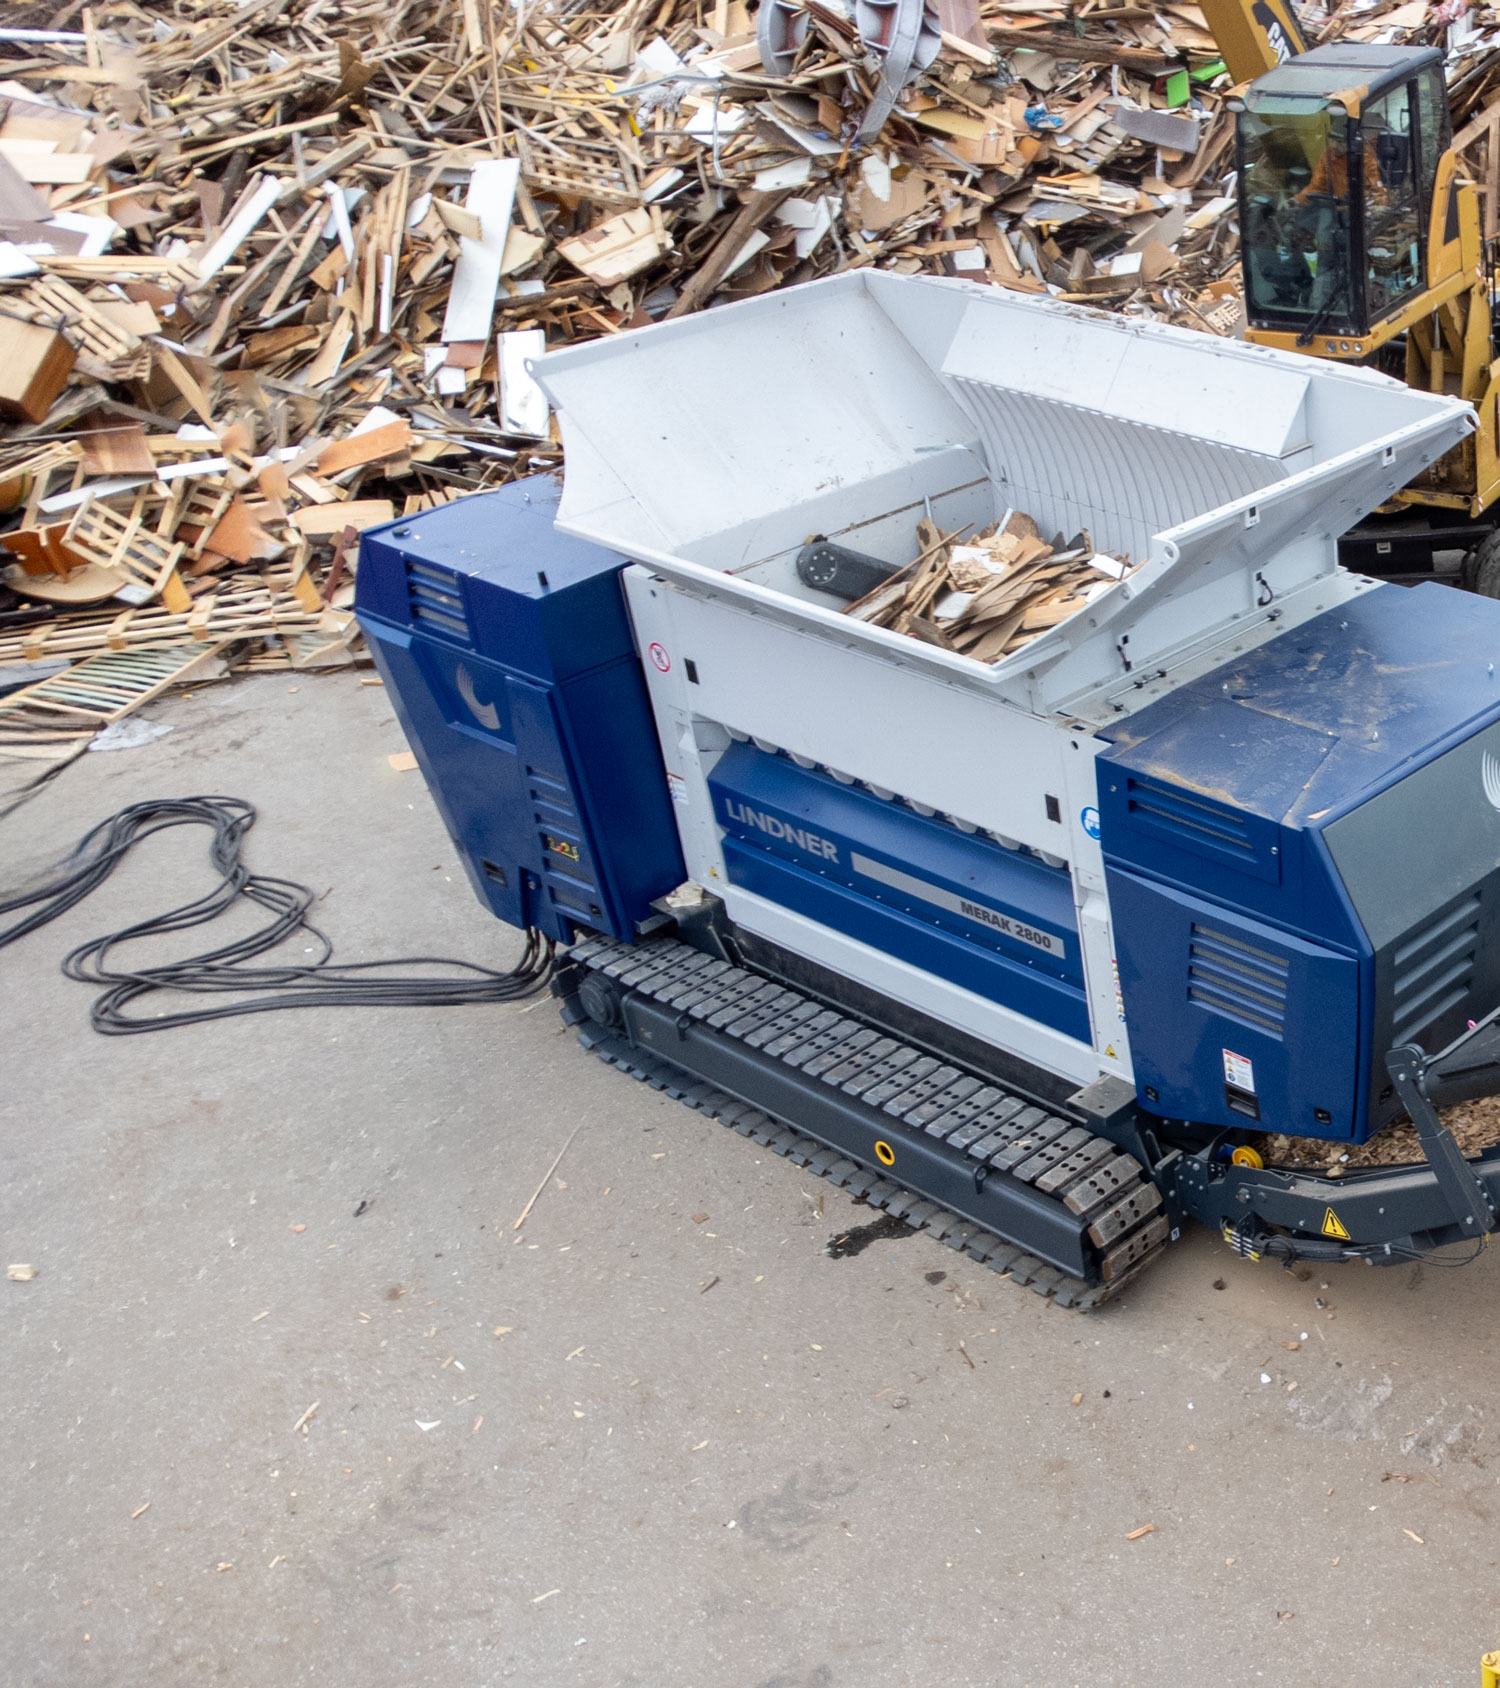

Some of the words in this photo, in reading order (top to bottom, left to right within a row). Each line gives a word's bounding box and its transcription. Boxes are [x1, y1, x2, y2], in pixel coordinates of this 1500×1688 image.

[1267, 21, 1291, 65] CAT
[725, 798, 840, 864] LINDNER
[960, 900, 1011, 932] MERAK
[1015, 924, 1052, 949] 2800
